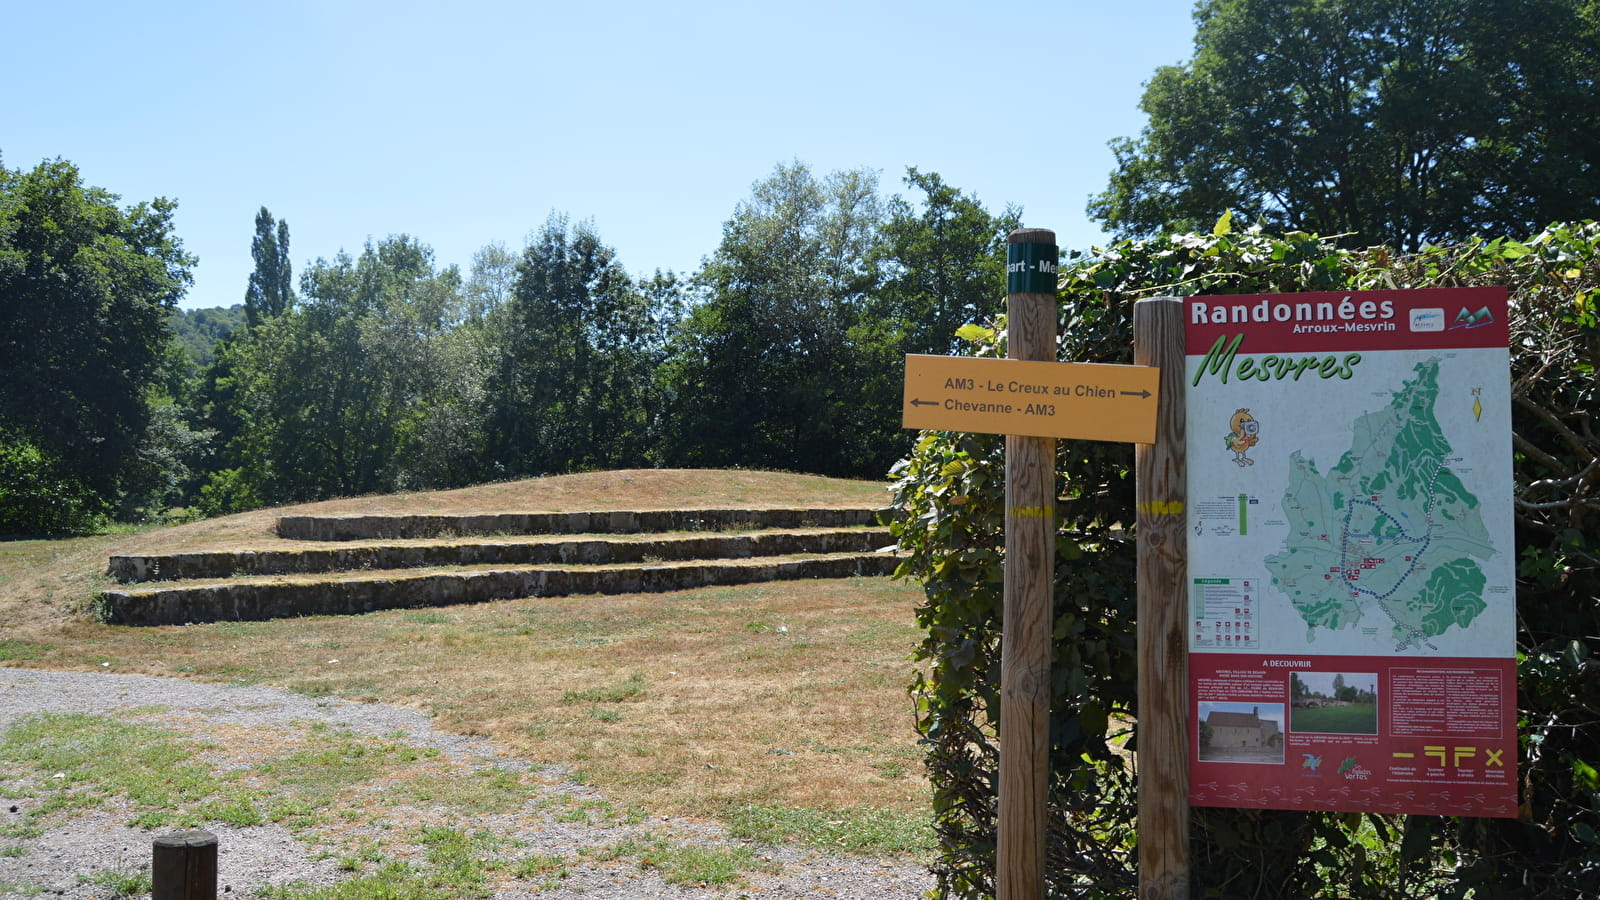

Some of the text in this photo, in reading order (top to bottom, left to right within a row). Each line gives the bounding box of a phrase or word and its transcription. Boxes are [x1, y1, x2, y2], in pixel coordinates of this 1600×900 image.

[1191, 296, 1395, 324] Randonnées
[1293, 321, 1396, 334] Arroux-Mesvrin
[1191, 333, 1362, 387] Mesvres
[944, 378, 975, 391] AM3
[987, 380, 1004, 392] Le
[1008, 381, 1049, 395] Creux
[1053, 385, 1070, 396] au
[1075, 384, 1116, 398] Chien
[944, 399, 1012, 414] Chevanne
[1024, 404, 1056, 416] AM3
[1270, 660, 1312, 668] DECOUVRIR
